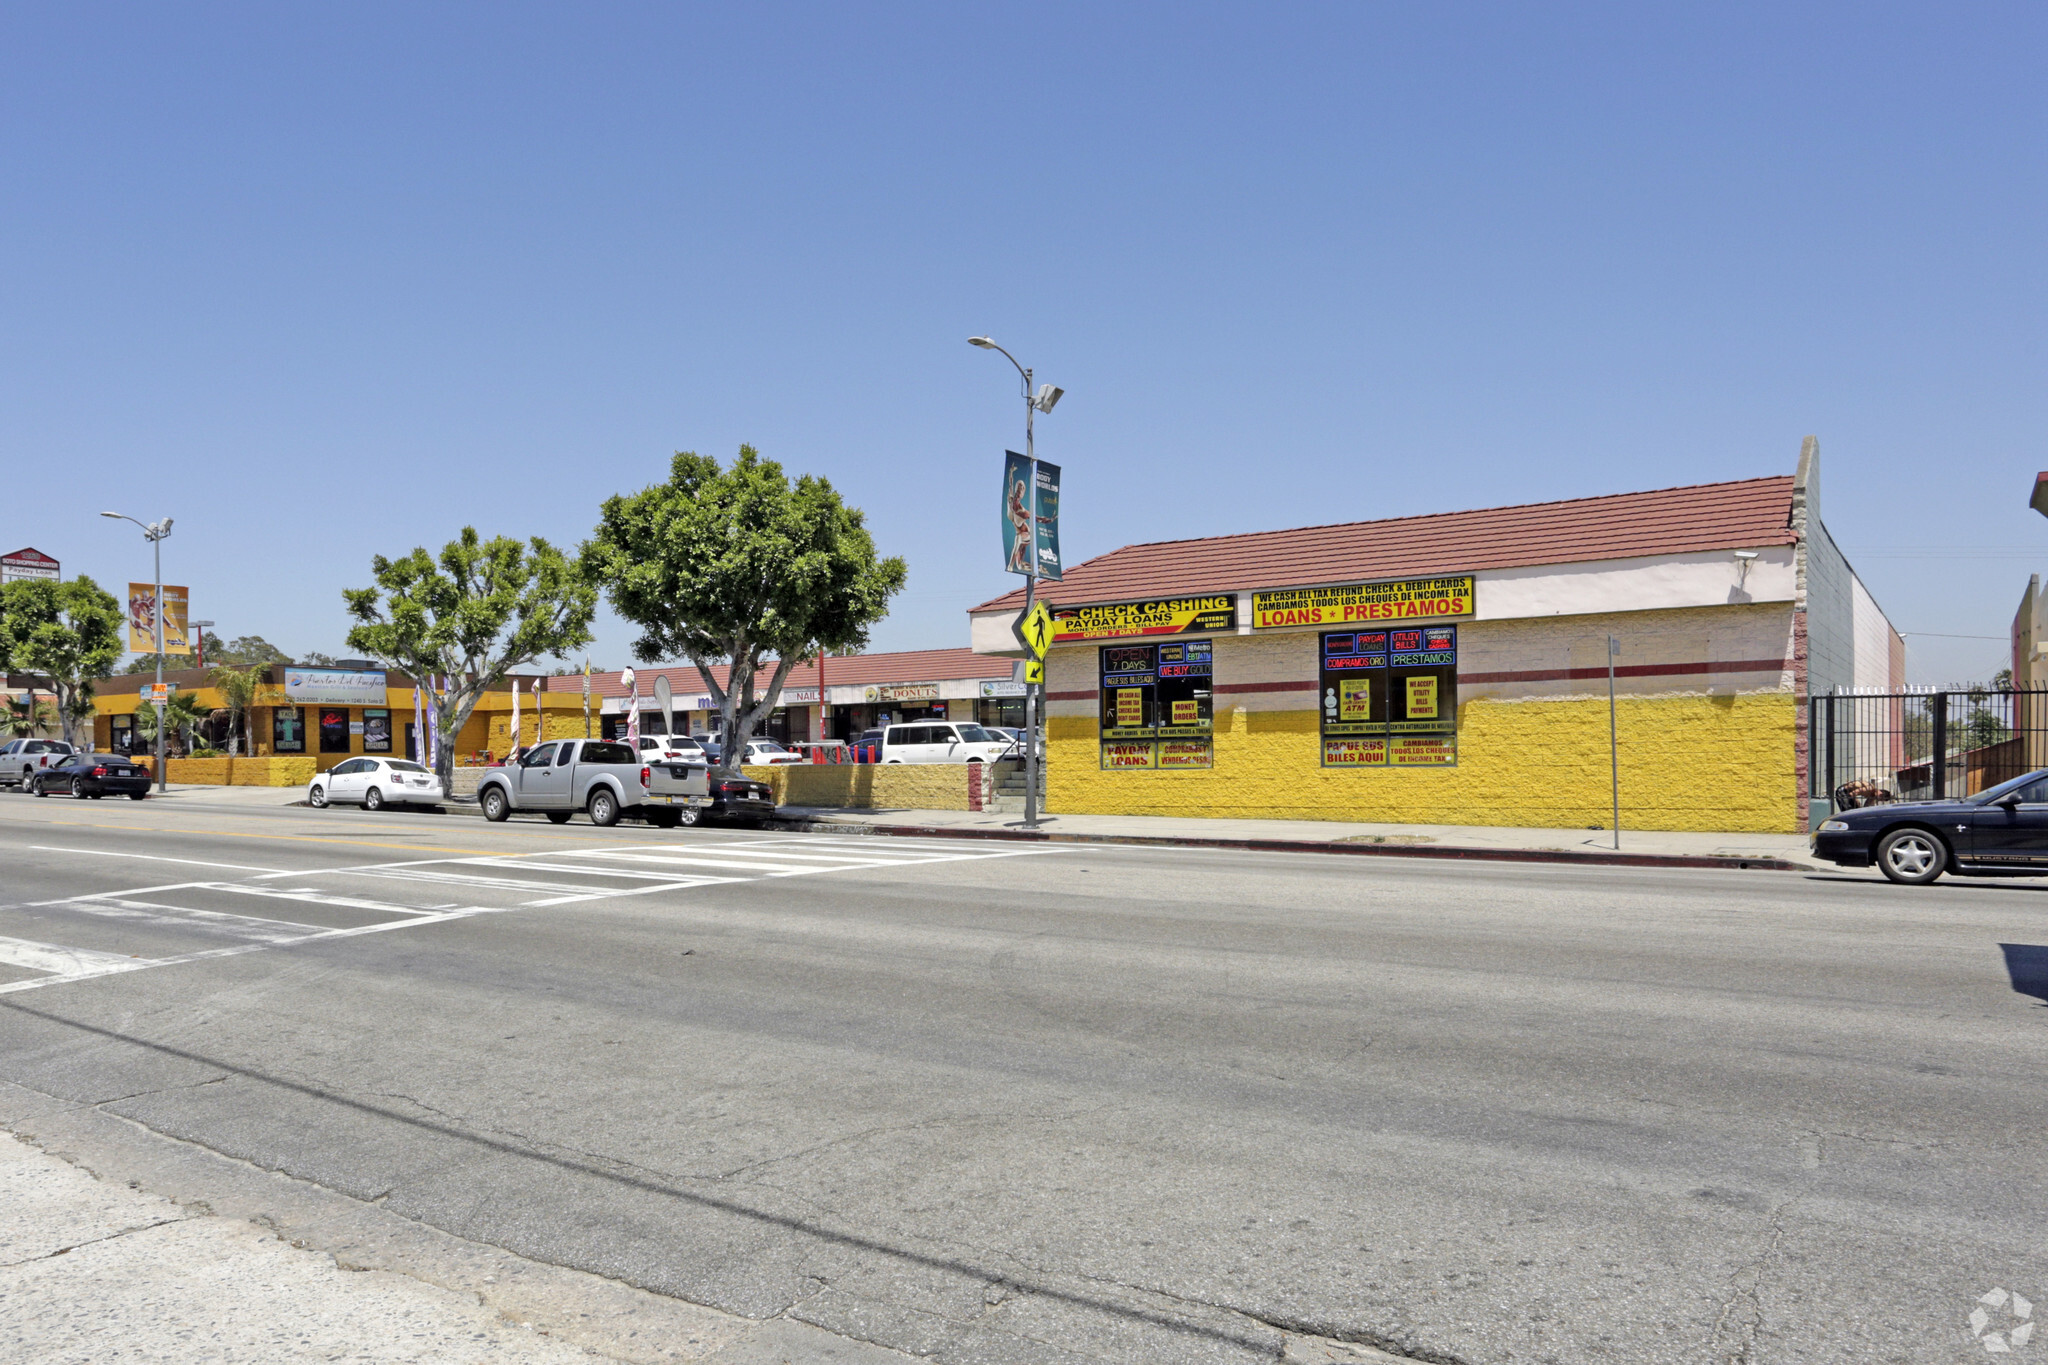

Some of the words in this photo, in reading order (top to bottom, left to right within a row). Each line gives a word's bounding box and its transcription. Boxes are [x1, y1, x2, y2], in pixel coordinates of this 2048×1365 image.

[8, 566, 33, 575] Payday
[1259, 593, 1271, 602] WE
[1273, 591, 1296, 601] CASH
[1298, 590, 1311, 600] ALL
[1312, 589, 1328, 599] TAX
[1330, 586, 1362, 598] REFUND
[1365, 584, 1394, 595] CHECK
[1396, 583, 1403, 592] &
[1405, 581, 1432, 591] DEBIT
[1433, 578, 1465, 589] CARDS
[1257, 600, 1309, 611] CAMBIAMOS
[1311, 597, 1340, 608] TODOS
[1342, 596, 1357, 606] LOS
[1358, 593, 1398, 605] CHEQUES
[1400, 592, 1411, 601] DE
[1413, 590, 1450, 601] INCOME
[1451, 588, 1469, 598] TAX
[1079, 604, 1137, 620] CHECK
[1145, 597, 1228, 614] CASHING
[1262, 607, 1322, 626] LOANS
[1343, 597, 1464, 621] PRESTAMOS
[1066, 617, 1117, 630] PAYDAY
[1124, 613, 1173, 623] LOANS
[1196, 615, 1224, 623] WESTERN
[1083, 630, 1109, 638] OPEN
[1119, 628, 1143, 636] DAYS
[1097, 624, 1127, 632] ORDERS
[1358, 635, 1386, 644] PAYDAY
[1392, 632, 1420, 641] UTILITY
[1359, 642, 1383, 651] LOANS
[1395, 641, 1416, 650] BILLS
[1110, 648, 1150, 661] OPEN
[1393, 653, 1452, 665] PRESTAMOS
[1112, 661, 1118, 669] 7
[1121, 660, 1146, 670] DAYS
[1327, 657, 1369, 668] COMPRAMOS
[1369, 656, 1384, 666] ORO
[1160, 666, 1172, 676] WE
[1173, 665, 1189, 676] BUY
[1190, 665, 1210, 675] GOLD
[1119, 675, 1129, 685] SUS
[893, 688, 938, 698] DONUTS
[1174, 703, 1195, 711] MONEY
[1345, 704, 1365, 712] ATM
[1174, 712, 1197, 721] ORDERS
[1107, 745, 1151, 755] PAYDAY
[1326, 741, 1360, 751] PAGUE
[1362, 741, 1384, 750] SUS
[1111, 756, 1148, 766] LOANS
[1327, 753, 1355, 763] BILES
[1358, 752, 1384, 762] AQUI
